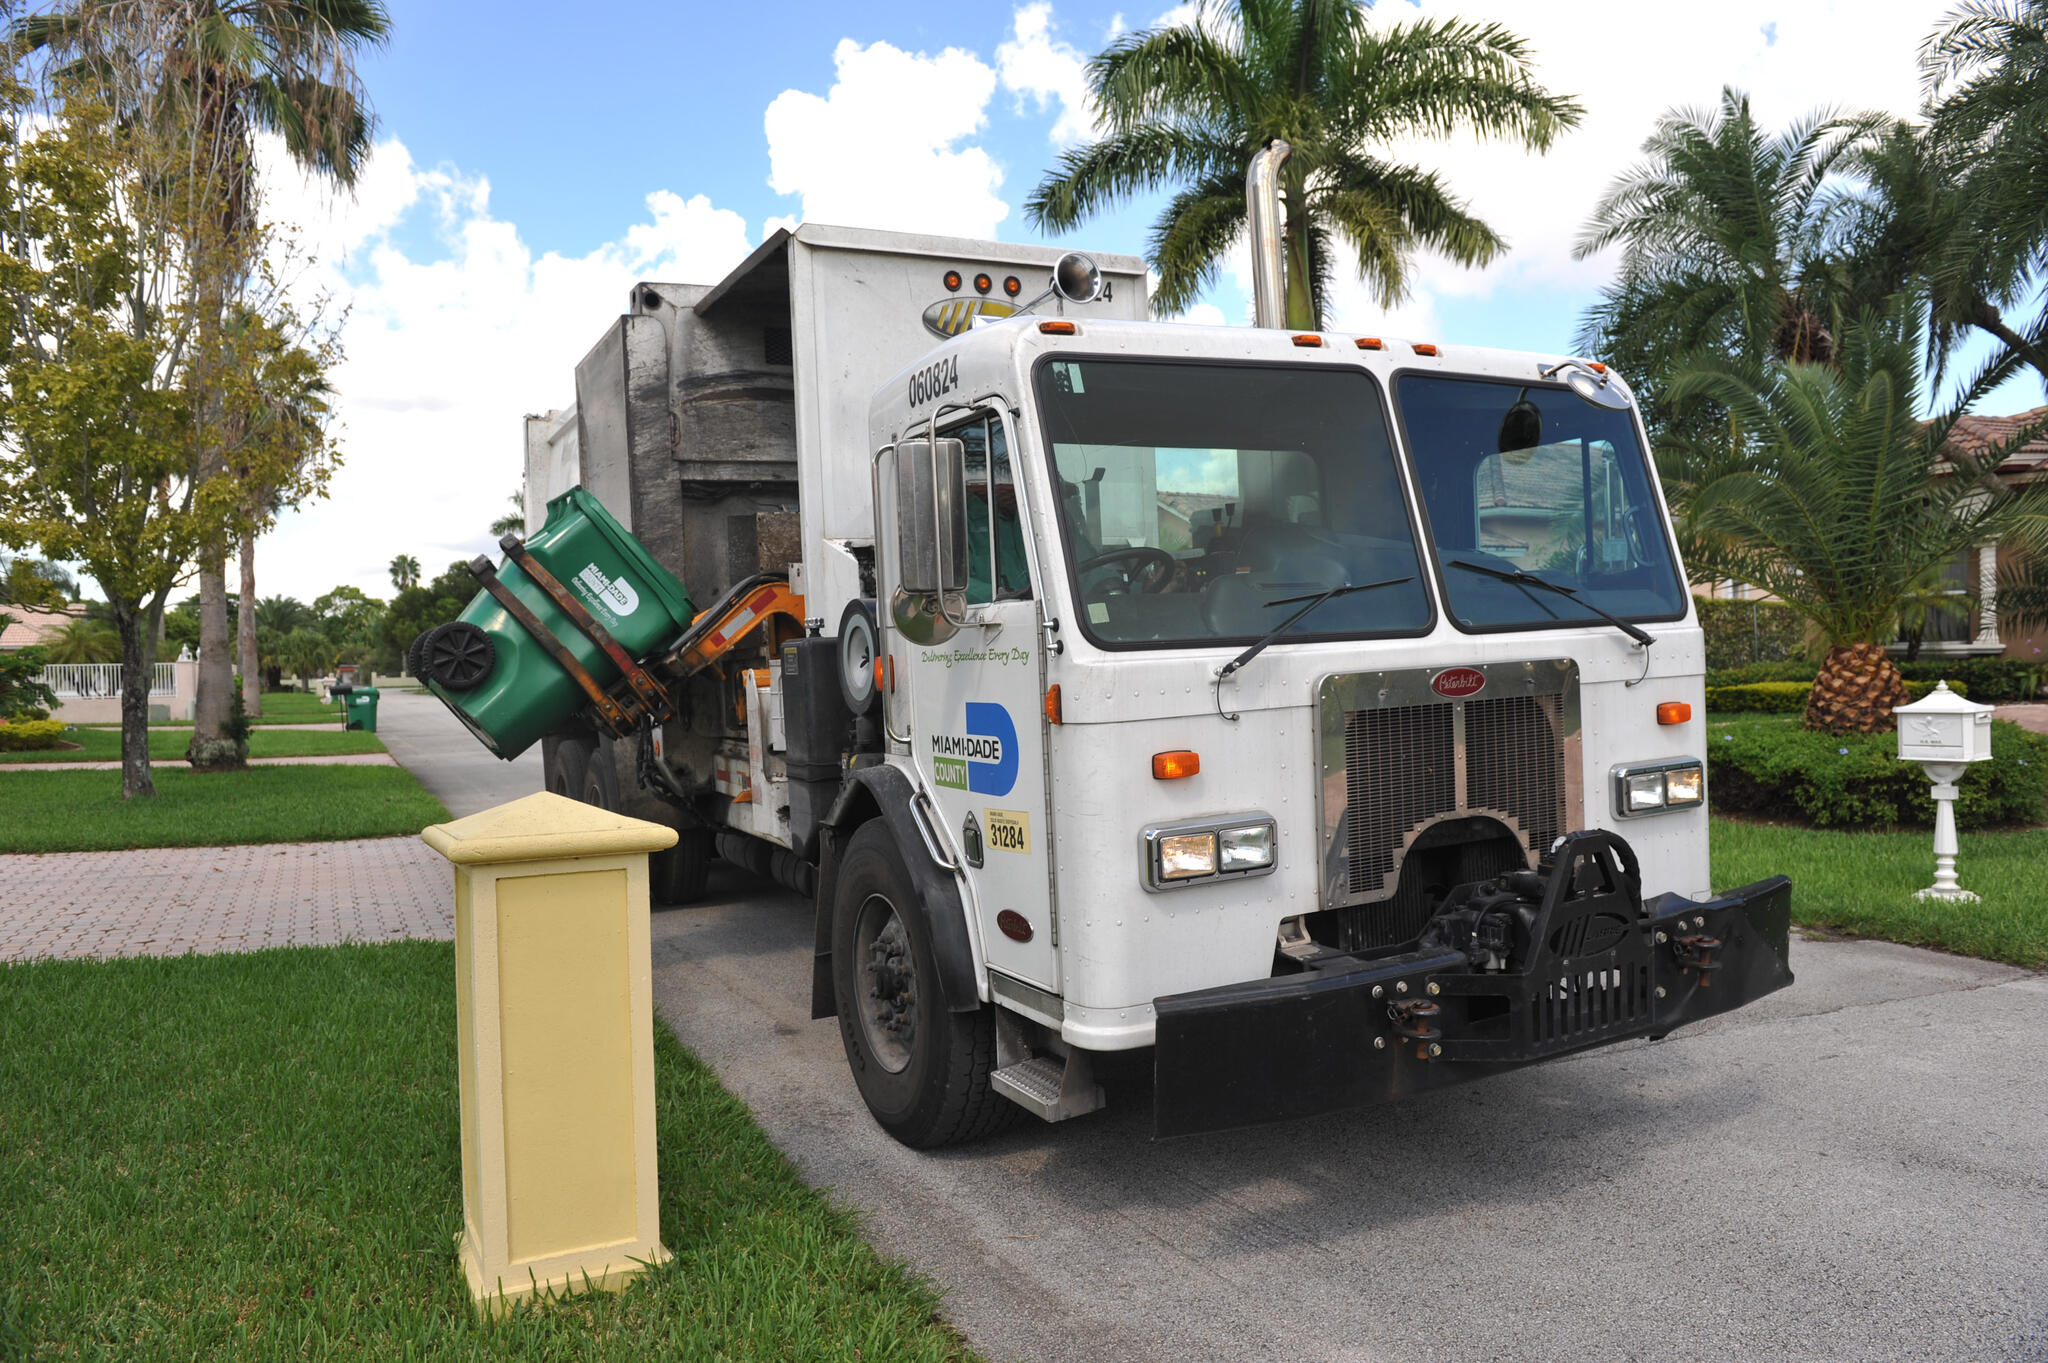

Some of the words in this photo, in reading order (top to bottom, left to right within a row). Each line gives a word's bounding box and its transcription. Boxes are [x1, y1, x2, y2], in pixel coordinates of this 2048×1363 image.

[908, 353, 959, 409] 060824
[921, 649, 953, 669] Delivering
[953, 647, 987, 663] Excellence
[988, 647, 1010, 666] Every
[1010, 646, 1030, 666] Day
[1439, 674, 1480, 691] Peterbilt
[934, 761, 966, 785] COUNTY
[990, 823, 1024, 849] 31284
